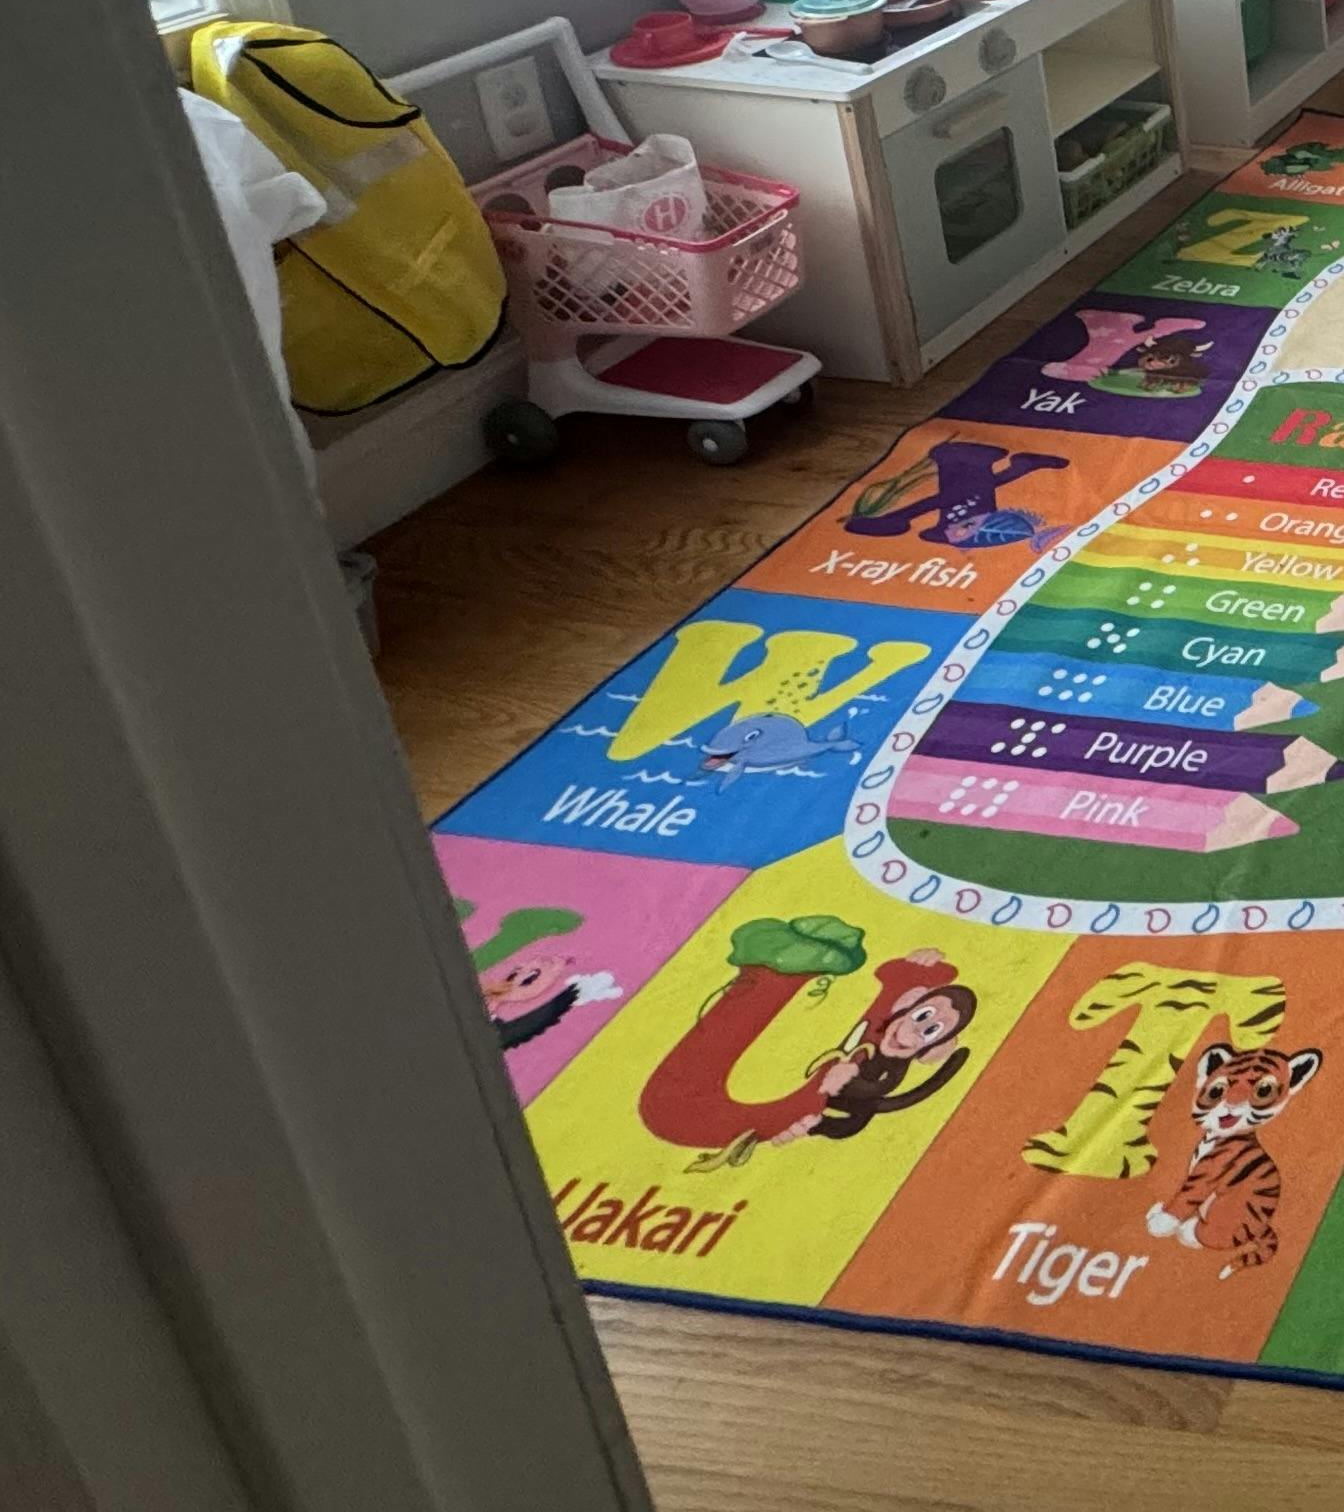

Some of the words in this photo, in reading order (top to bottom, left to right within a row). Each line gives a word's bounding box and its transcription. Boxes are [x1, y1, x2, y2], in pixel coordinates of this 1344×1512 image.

[1151, 274, 1241, 299] Zebra
[1019, 387, 1090, 416] Yak
[807, 549, 907, 587] X-ray
[907, 554, 980, 591] fish
[1239, 551, 1344, 582] Yellow
[1205, 589, 1307, 623] Green
[1181, 636, 1267, 671] Cyan
[606, 619, 932, 762] W
[1143, 686, 1227, 718] Blue
[1083, 731, 1209, 777] Purple
[542, 784, 700, 837] Whale
[1058, 789, 1146, 829] Pink
[991, 1221, 1152, 1307] Tiger
